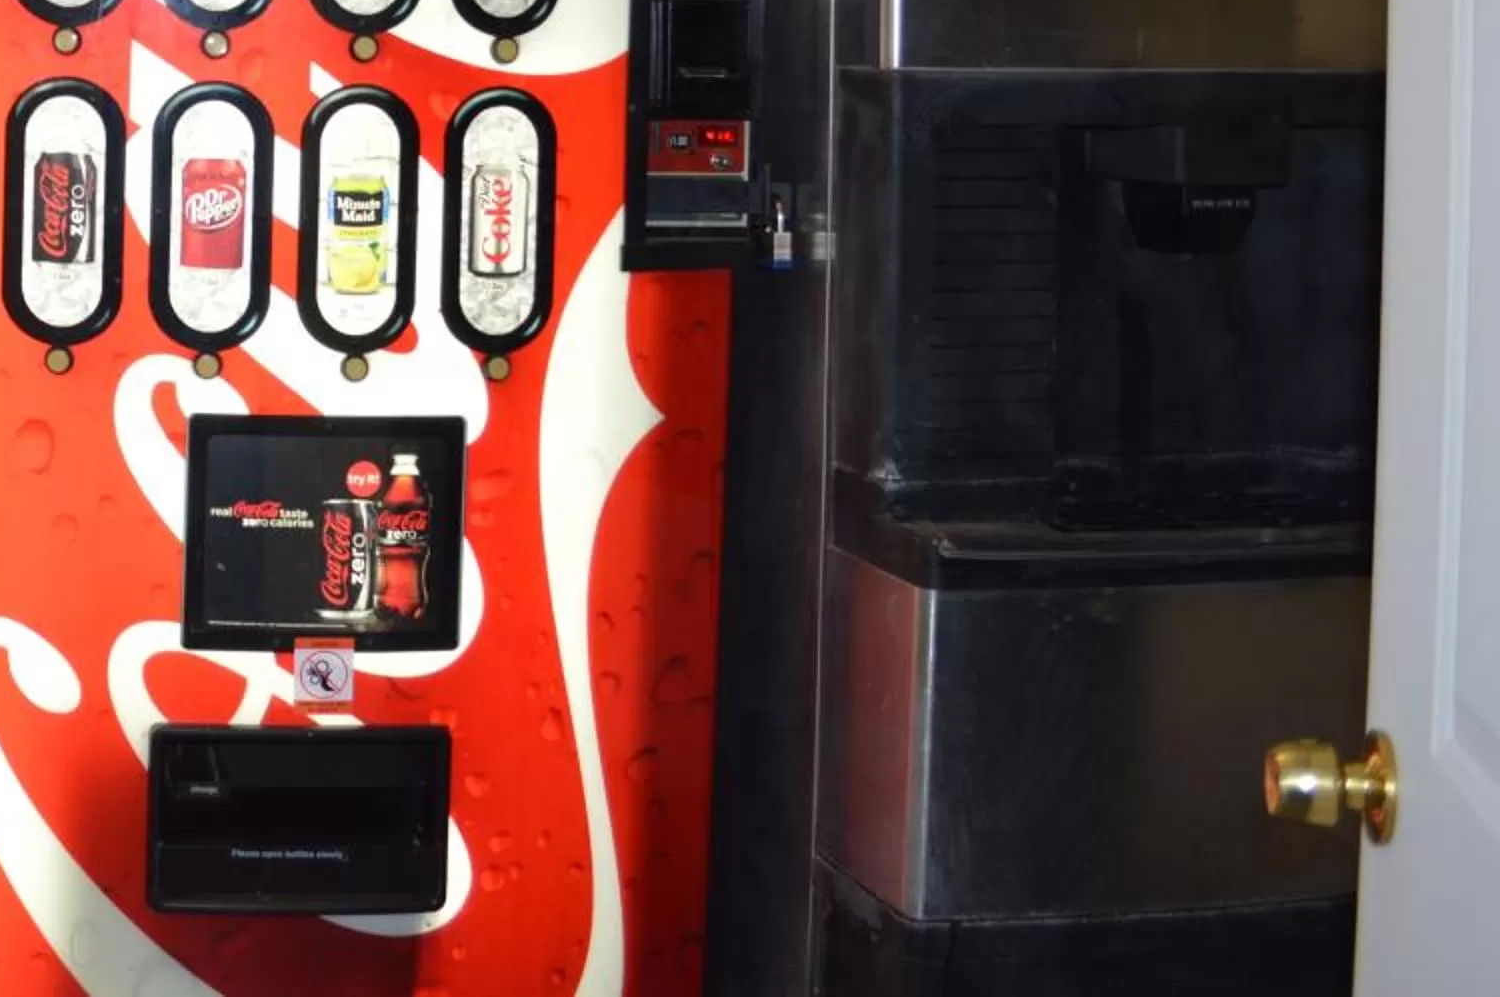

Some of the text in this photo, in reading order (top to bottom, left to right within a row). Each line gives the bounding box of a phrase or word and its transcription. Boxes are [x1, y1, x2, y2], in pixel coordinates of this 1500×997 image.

[204, 187, 229, 209] Dr
[336, 195, 381, 210] Minute
[69, 184, 85, 237] zero
[190, 193, 239, 226] Pepper
[341, 207, 376, 223] Maid
[481, 175, 513, 265] Coke
[347, 474, 366, 488] try
[209, 506, 233, 519] real
[280, 507, 309, 519] taste
[242, 517, 315, 530] zero calories
[386, 529, 418, 541] zero
[351, 532, 366, 586] zero
